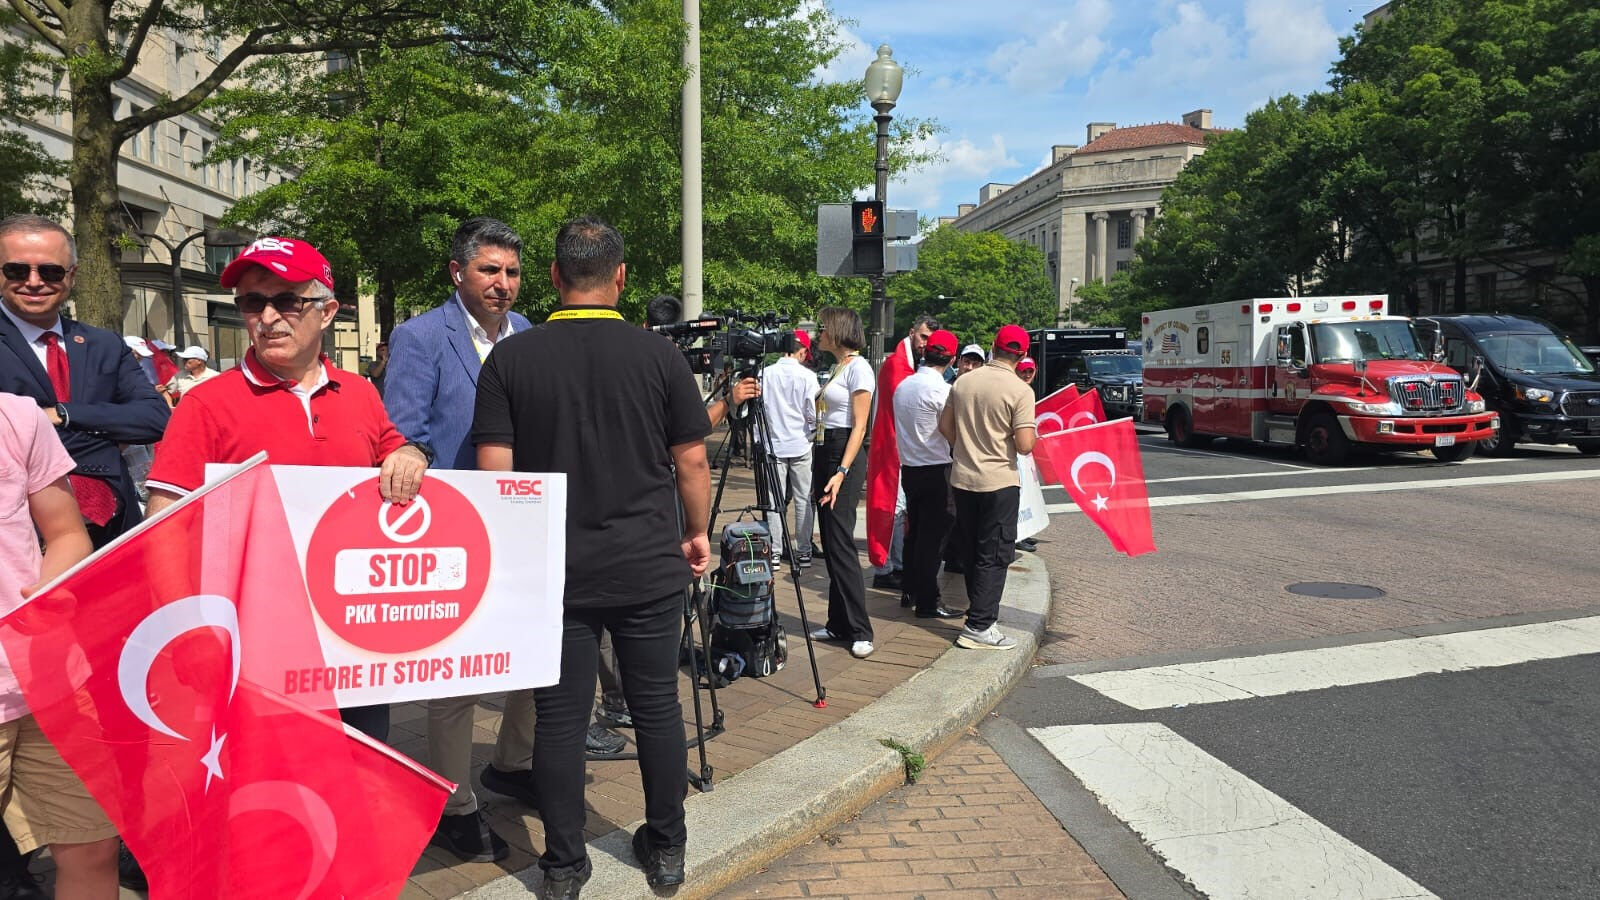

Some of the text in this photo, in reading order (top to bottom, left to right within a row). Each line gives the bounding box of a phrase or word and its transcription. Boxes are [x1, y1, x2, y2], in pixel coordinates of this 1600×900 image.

[1221, 349, 1231, 364] 55
[496, 479, 542, 496] TASC
[368, 553, 437, 587] STOP
[345, 600, 460, 625] PKK Terrorism
[284, 651, 511, 695] BEFORE IT STOPS NATO!
